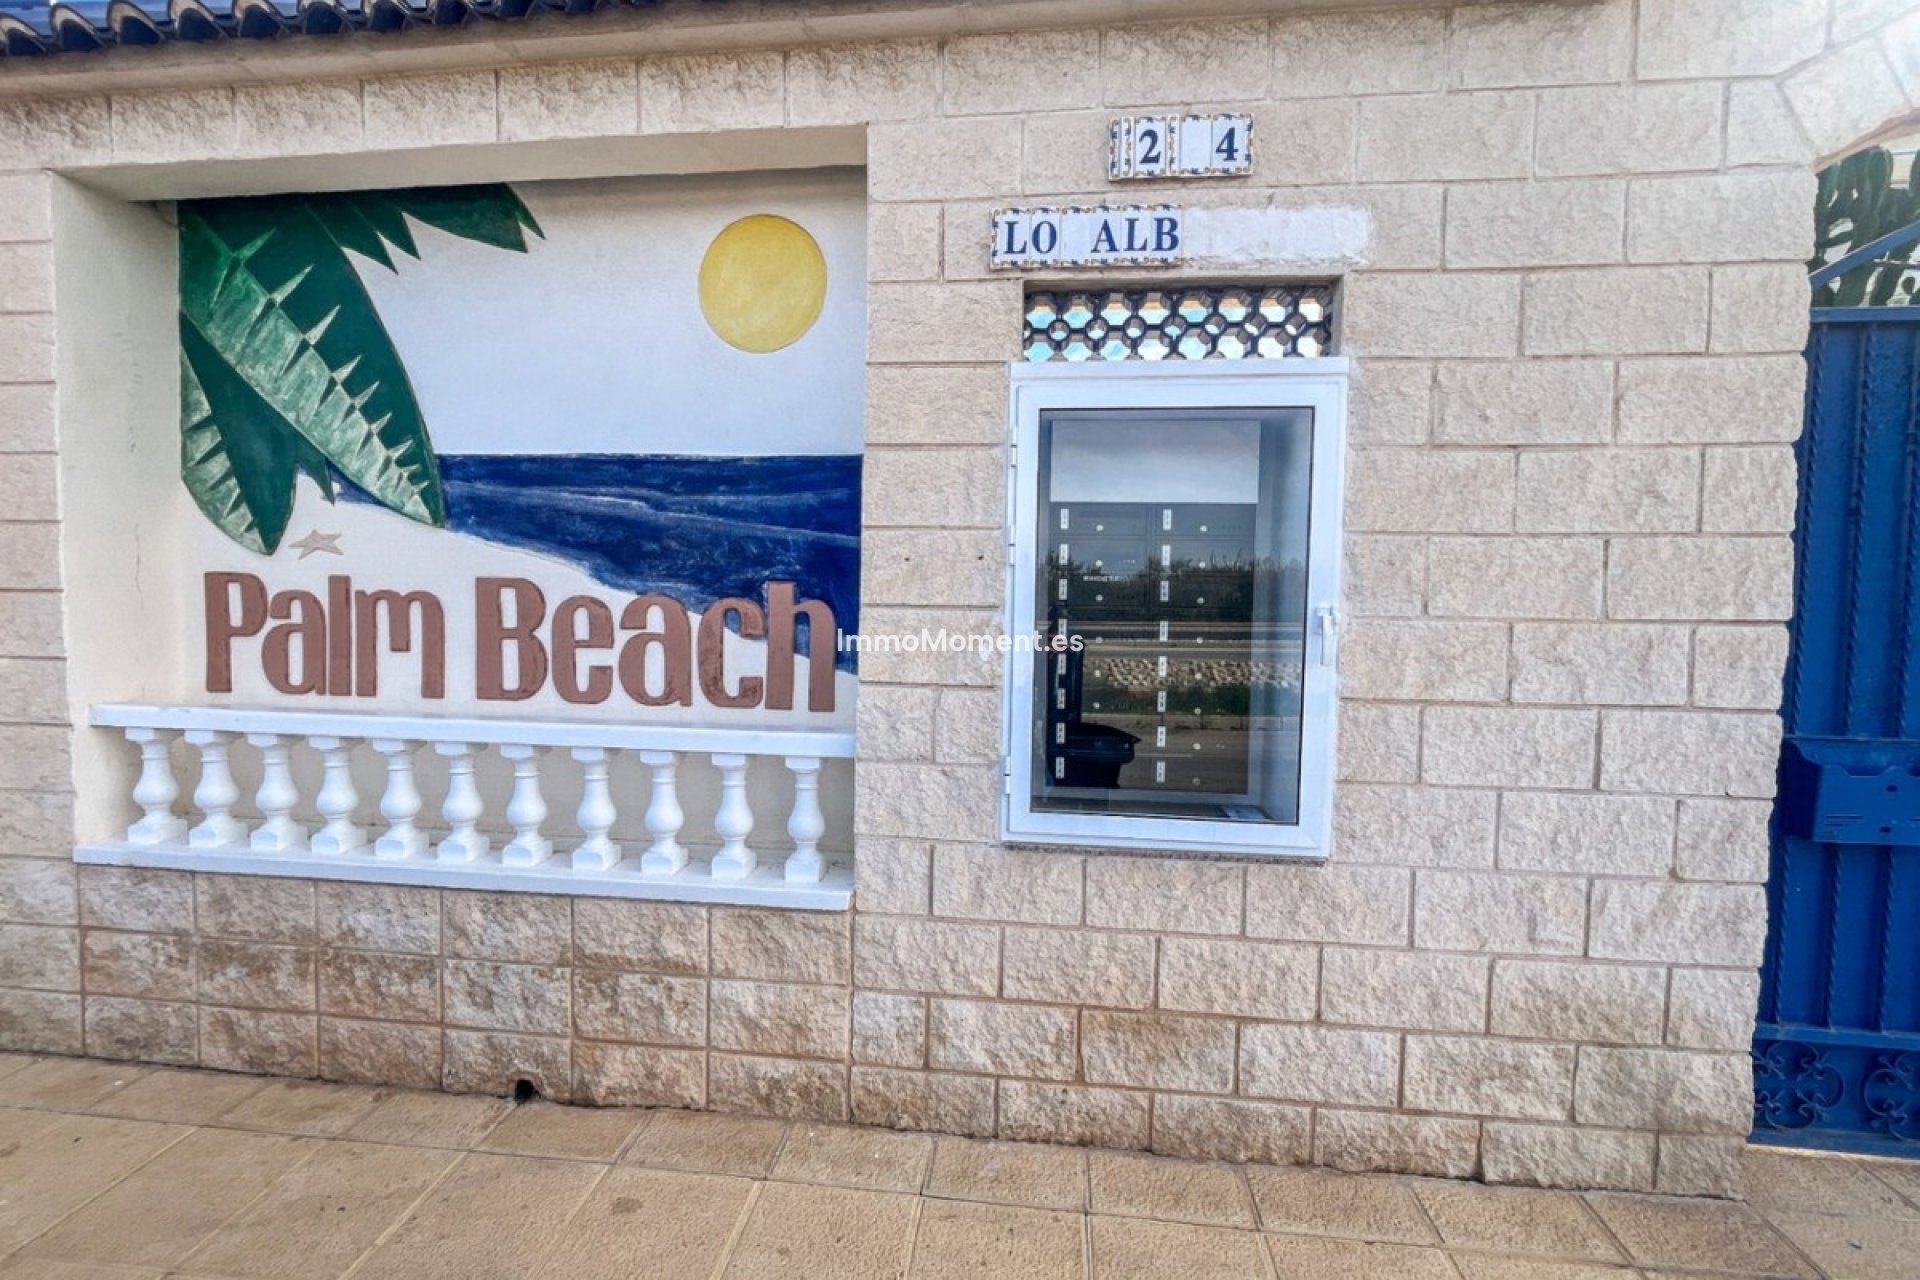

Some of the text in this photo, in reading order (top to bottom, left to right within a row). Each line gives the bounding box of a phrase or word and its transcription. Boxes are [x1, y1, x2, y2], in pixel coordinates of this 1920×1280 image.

[1005, 216, 1180, 254] LO ALB
[204, 571, 836, 713] Palm Beach
